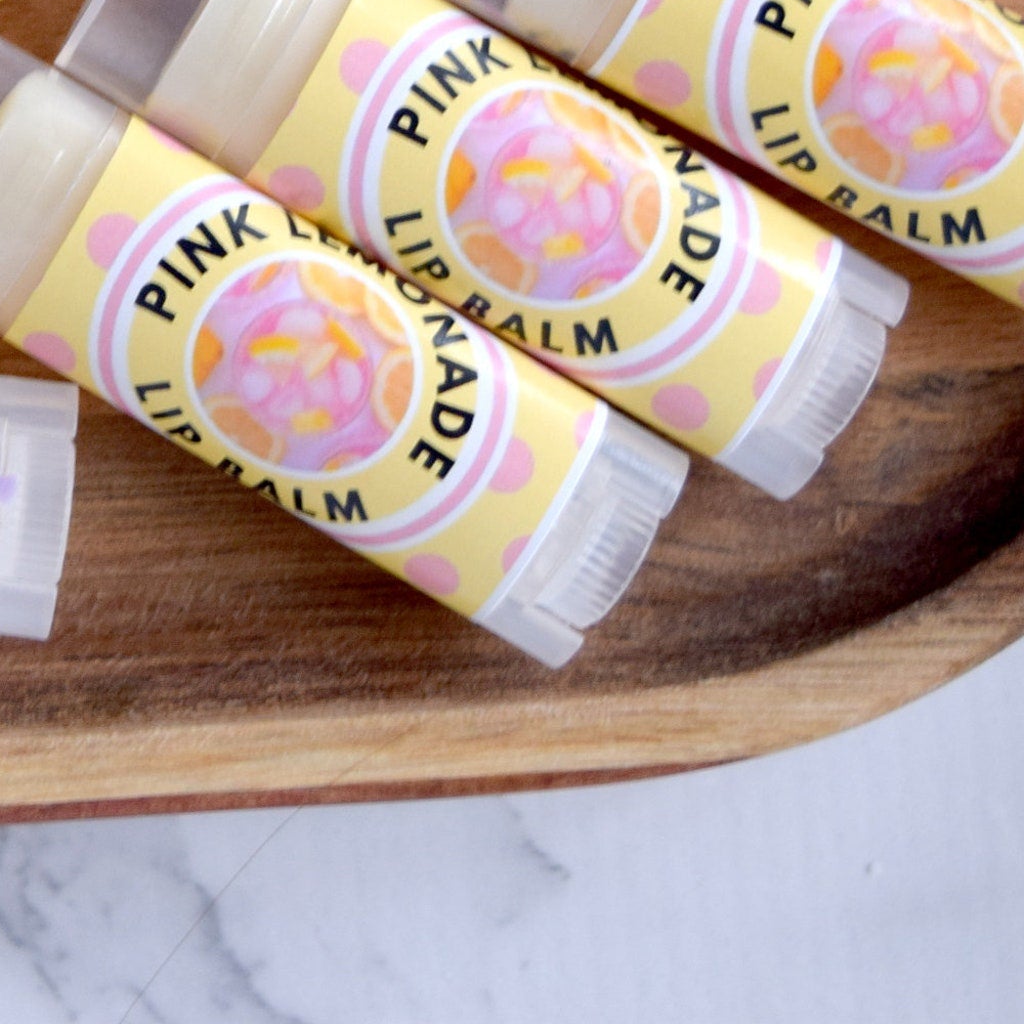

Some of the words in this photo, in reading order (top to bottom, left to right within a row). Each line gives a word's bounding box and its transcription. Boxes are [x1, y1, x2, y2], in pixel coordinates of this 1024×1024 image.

[387, 36, 511, 148] PINK
[750, 103, 818, 174] LIP
[827, 184, 987, 246] BALM
[134, 201, 269, 323] PINK
[384, 209, 451, 281] LIP
[461, 292, 619, 356] BALM
[135, 382, 202, 444] LIP
